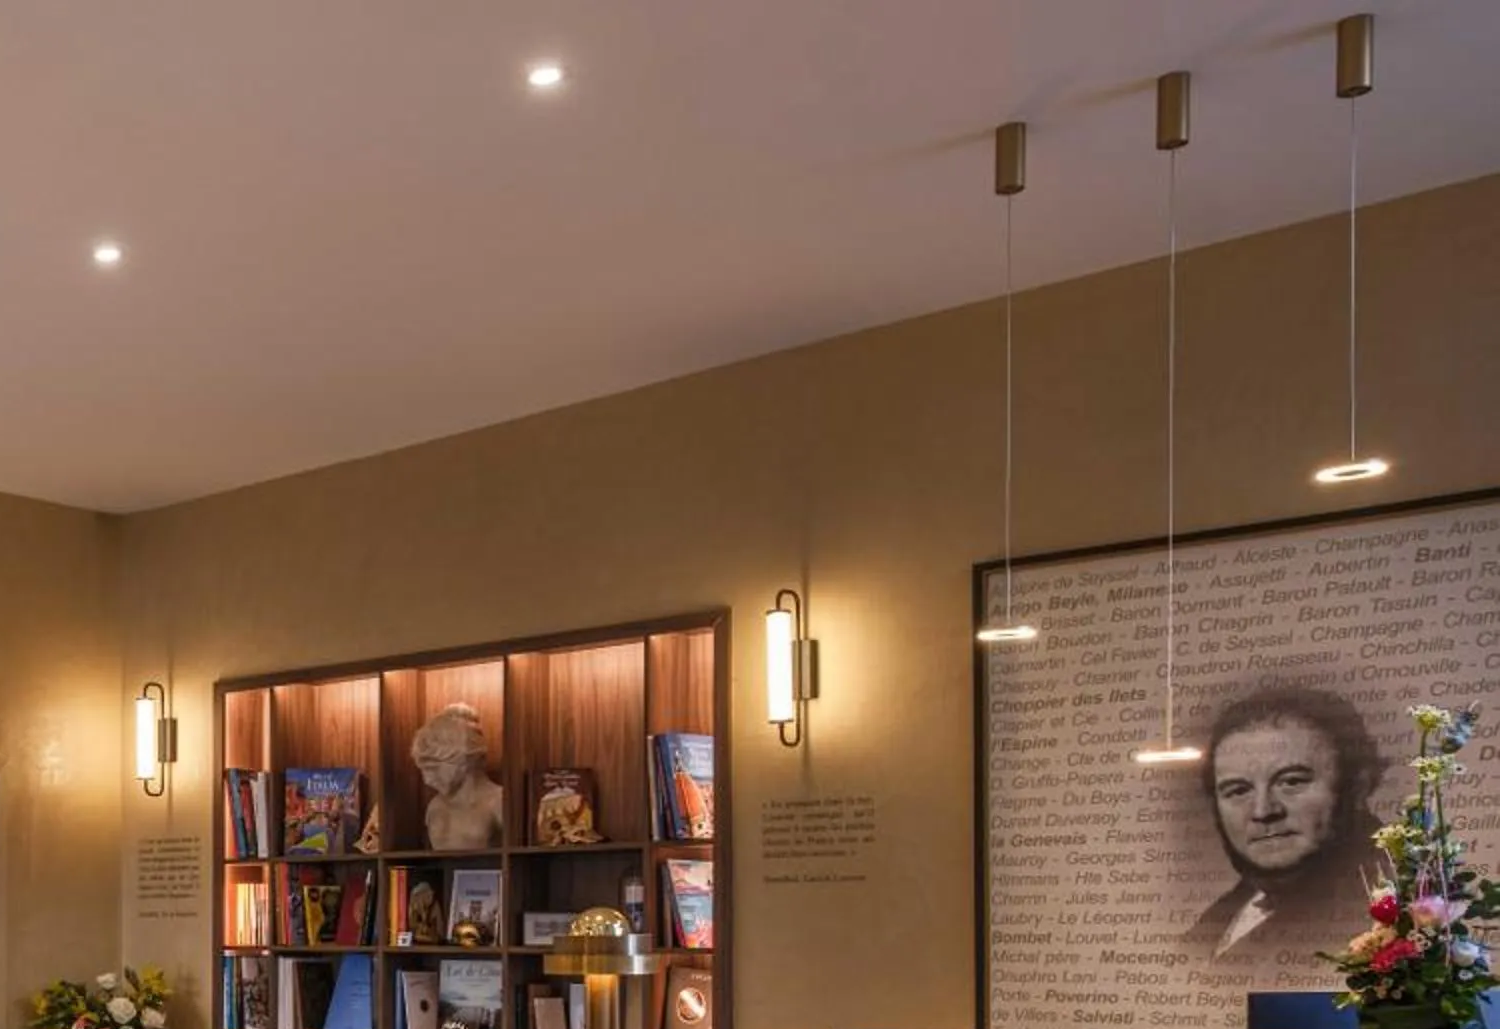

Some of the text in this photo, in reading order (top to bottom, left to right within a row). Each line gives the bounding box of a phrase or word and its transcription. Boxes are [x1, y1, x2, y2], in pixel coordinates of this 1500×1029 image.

[1315, 527, 1430, 555] Champagne
[1414, 540, 1472, 563] Banti
[1110, 605, 1162, 623] Baron
[1261, 586, 1318, 605] Baron
[1411, 567, 1472, 587] Baron
[1298, 602, 1360, 623] Baron
[1310, 617, 1424, 643] Champagne
[1360, 635, 1456, 660] Chinchilla
[1101, 948, 1190, 969] Mocenigo
[1044, 988, 1121, 1004] Poverino
